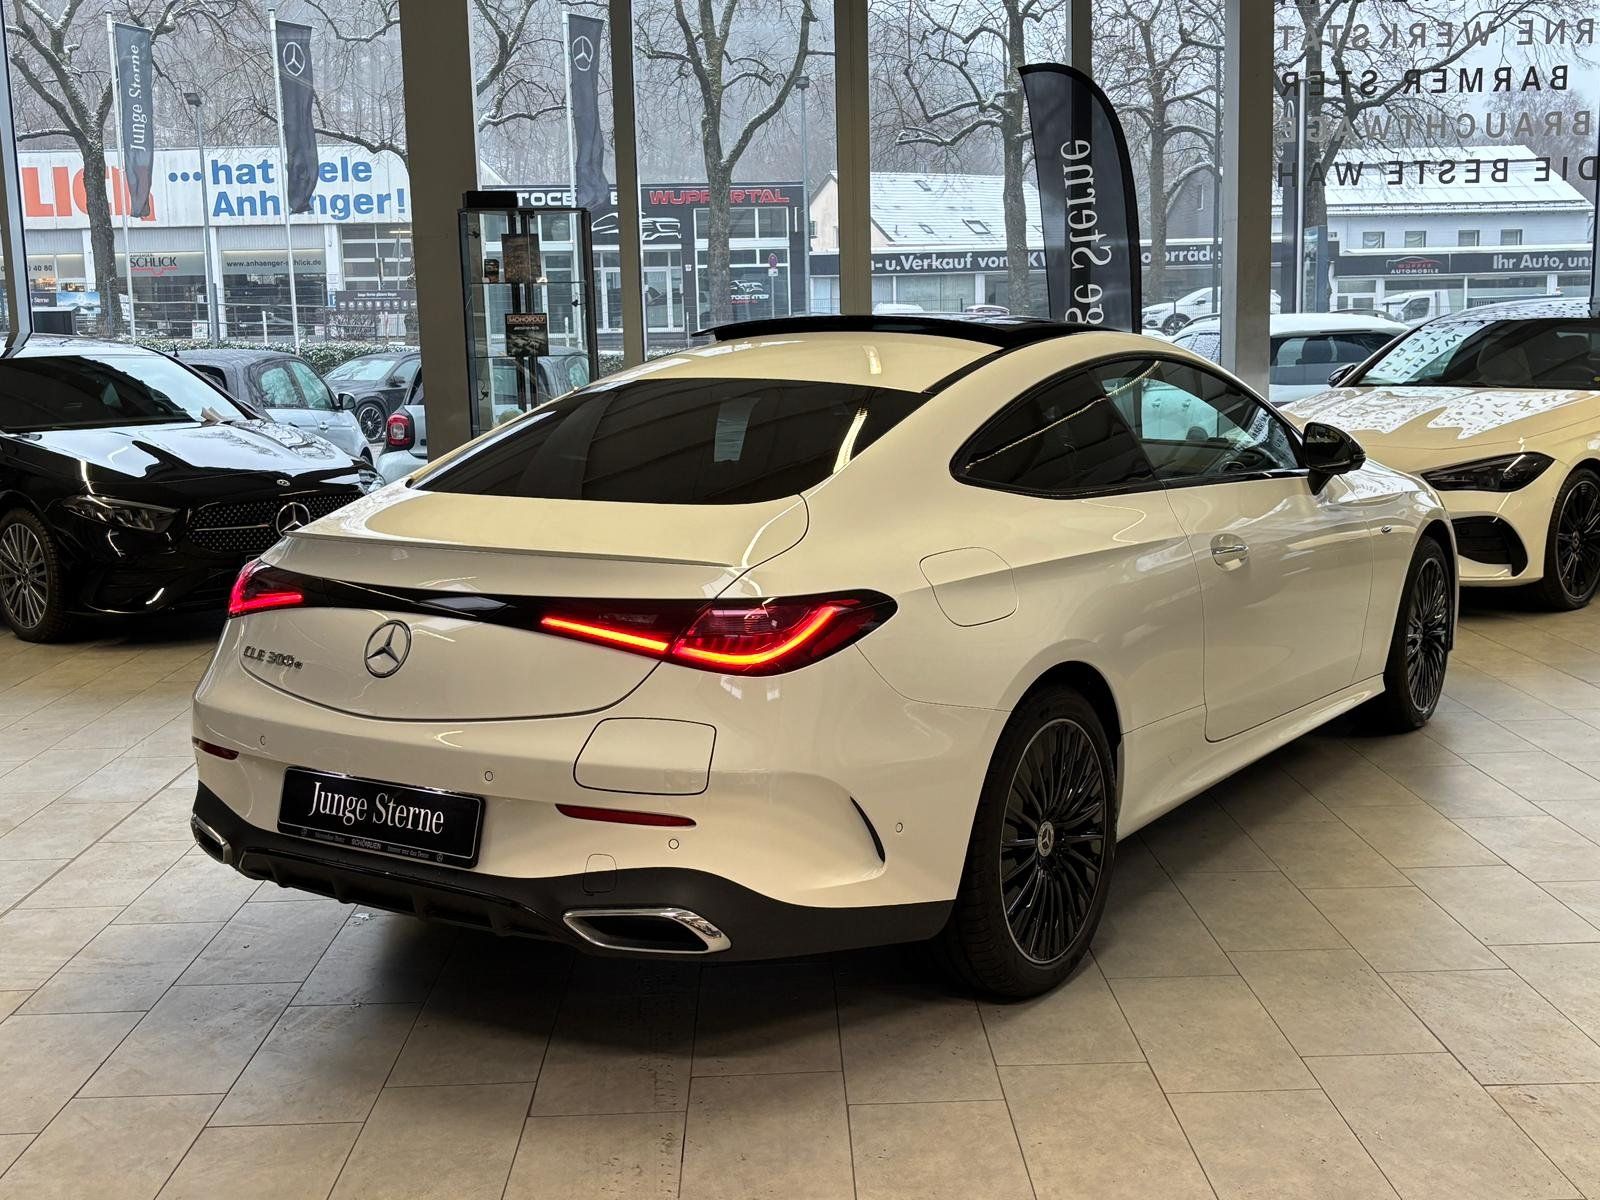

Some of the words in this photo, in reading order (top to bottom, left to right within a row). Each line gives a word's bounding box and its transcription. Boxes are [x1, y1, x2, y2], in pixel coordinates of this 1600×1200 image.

[128, 45, 142, 98] Sterne
[130, 104, 147, 151] Junge
[212, 188, 406, 221] Anhnger!
[649, 188, 790, 205] WUPPRTAL
[129, 256, 177, 268] SCHLICK
[226, 259, 322, 268] www.anhaenger-shlick.de
[977, 255, 1008, 268] von
[1492, 254, 1517, 270] Ihr
[1520, 253, 1564, 270] Auto,
[243, 646, 265, 662] CLE
[308, 781, 368, 826] Junge
[372, 792, 445, 835] Sterne
